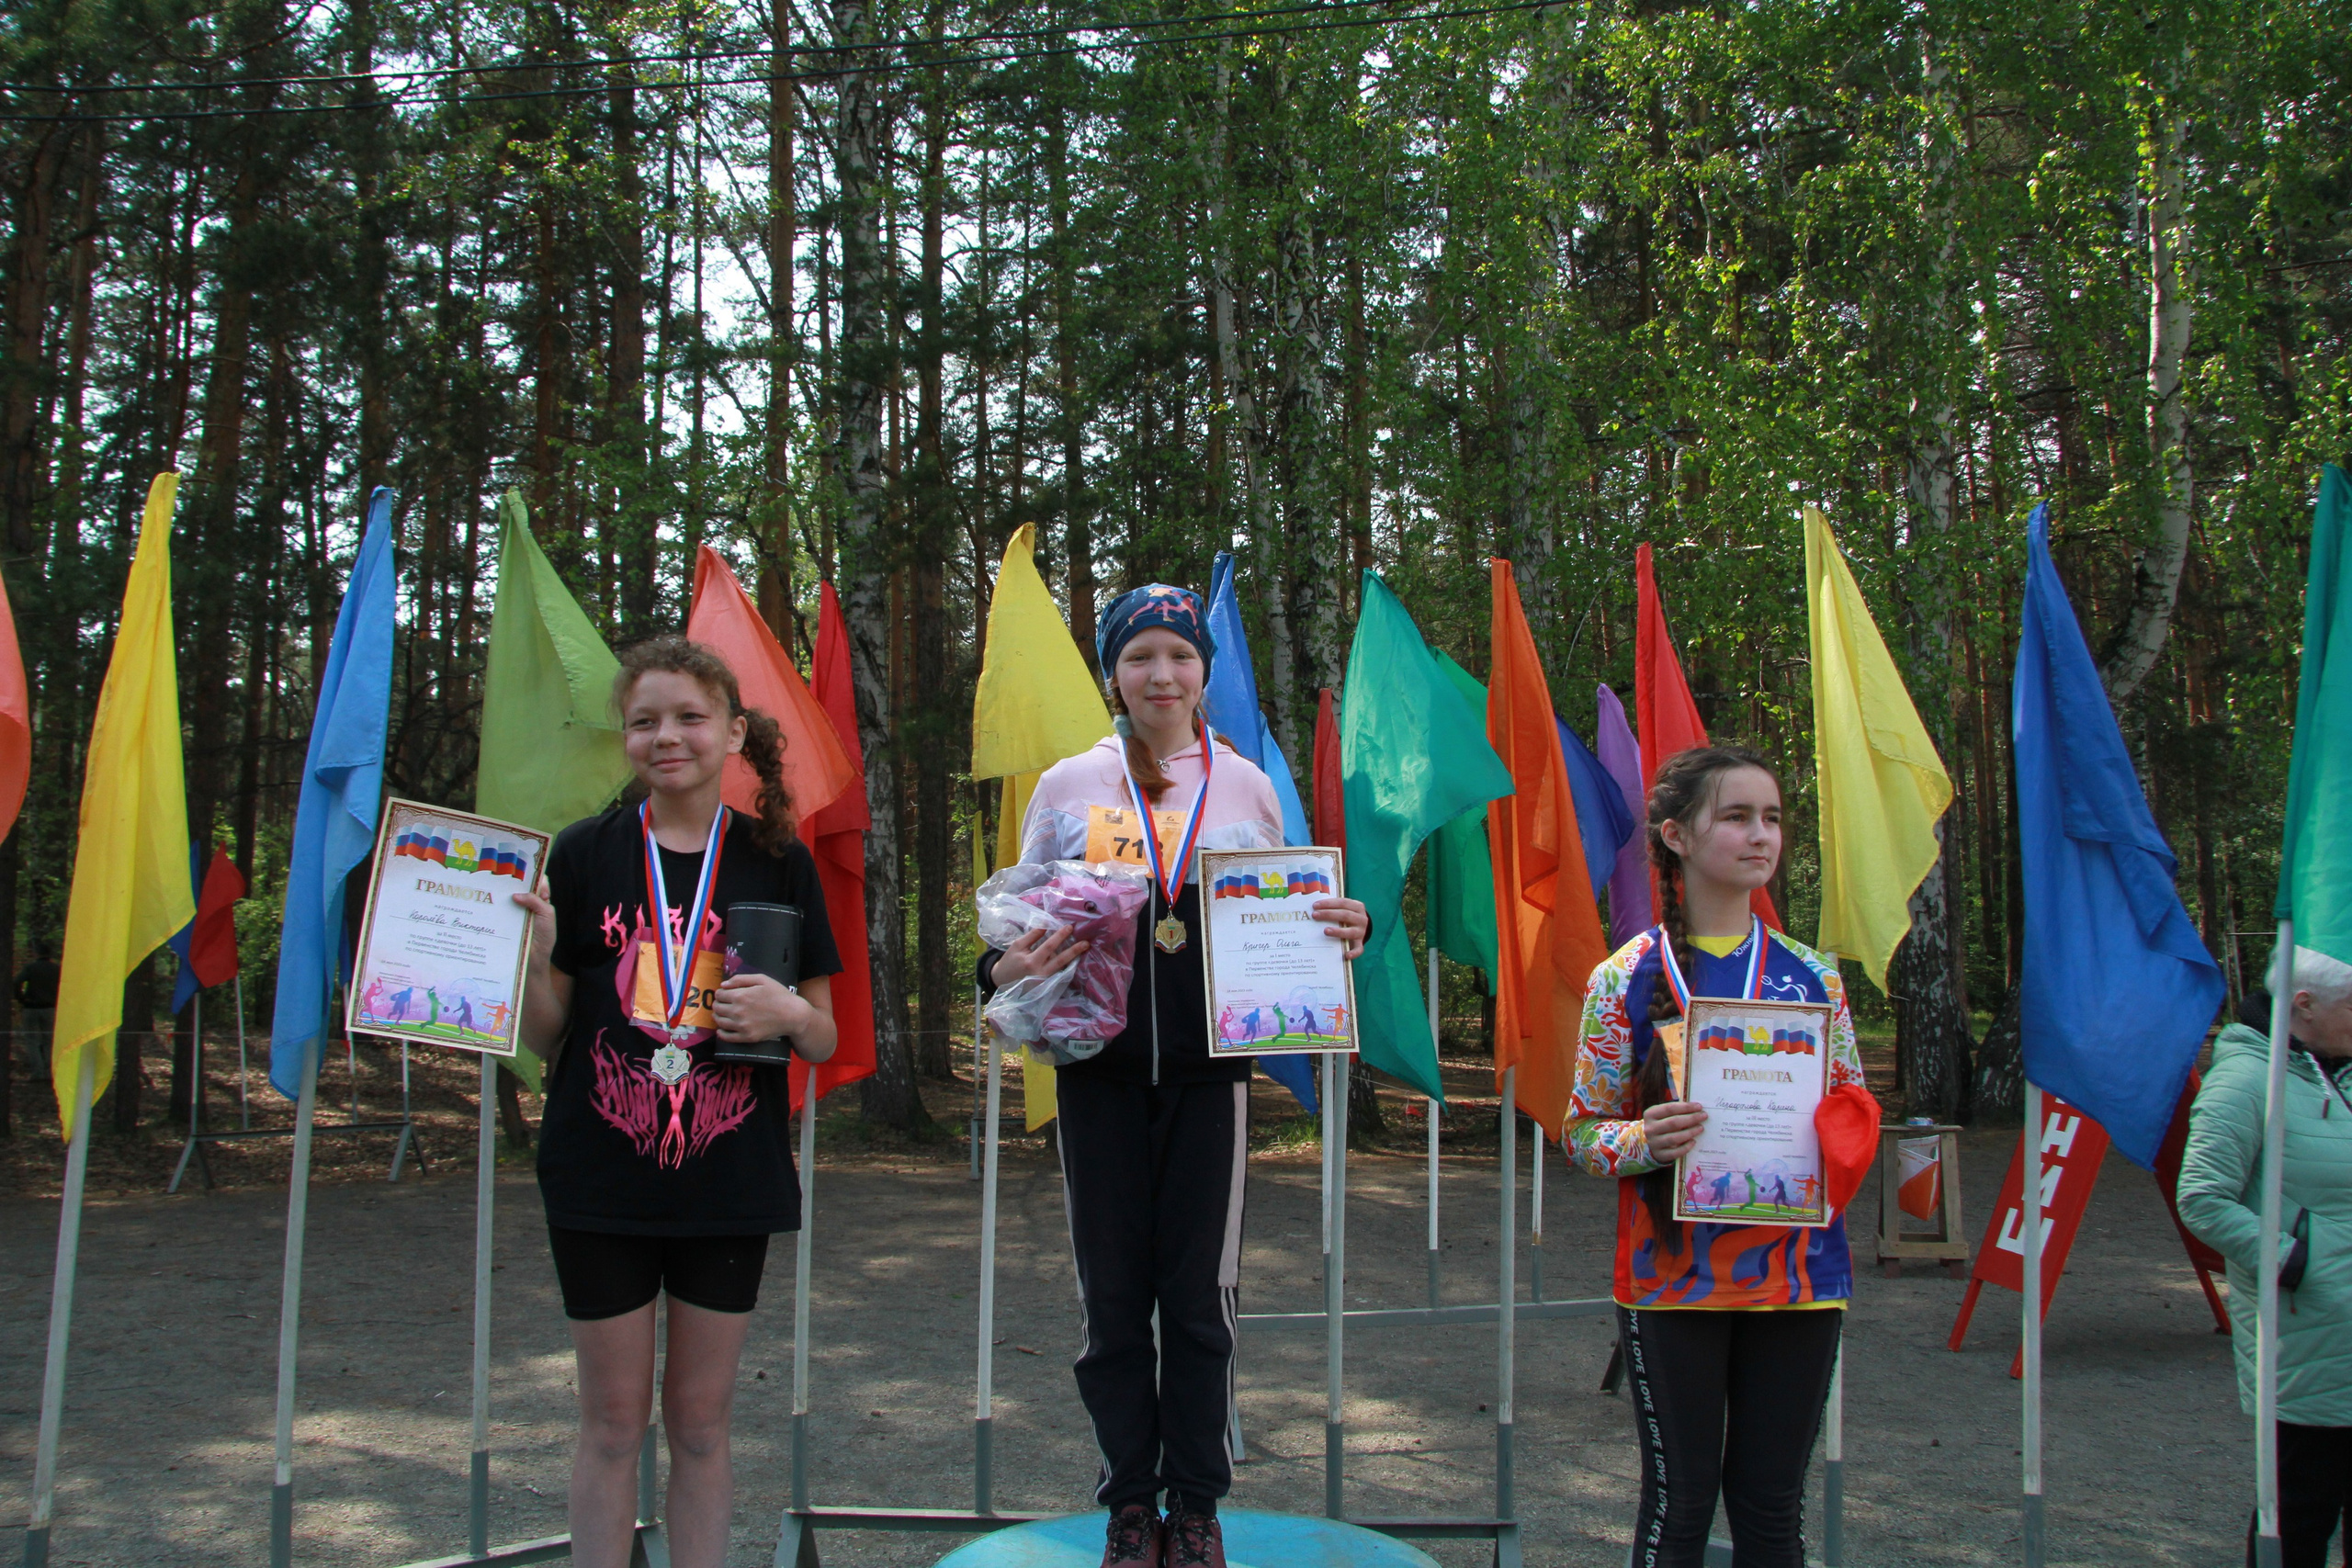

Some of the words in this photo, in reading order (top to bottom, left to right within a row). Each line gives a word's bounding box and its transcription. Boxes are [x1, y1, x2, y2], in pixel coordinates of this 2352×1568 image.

[415, 878, 493, 904] ГРАМОТА
[1240, 910, 1310, 924] ГРАМОТА
[1169, 930, 1174, 940] 1
[666, 1059, 674, 1069] 2
[1722, 1068, 1792, 1082] ГРАМОТА
[1996, 1098, 2081, 1258] НИШ
[1629, 1310, 1639, 1335] OVE
[1632, 1340, 1645, 1374] LOVE
[1638, 1379, 1654, 1413] LOVE
[1647, 1416, 1663, 1450] LOVE
[1655, 1452, 1667, 1484] LOVE
[1656, 1487, 1668, 1518] LOVE
